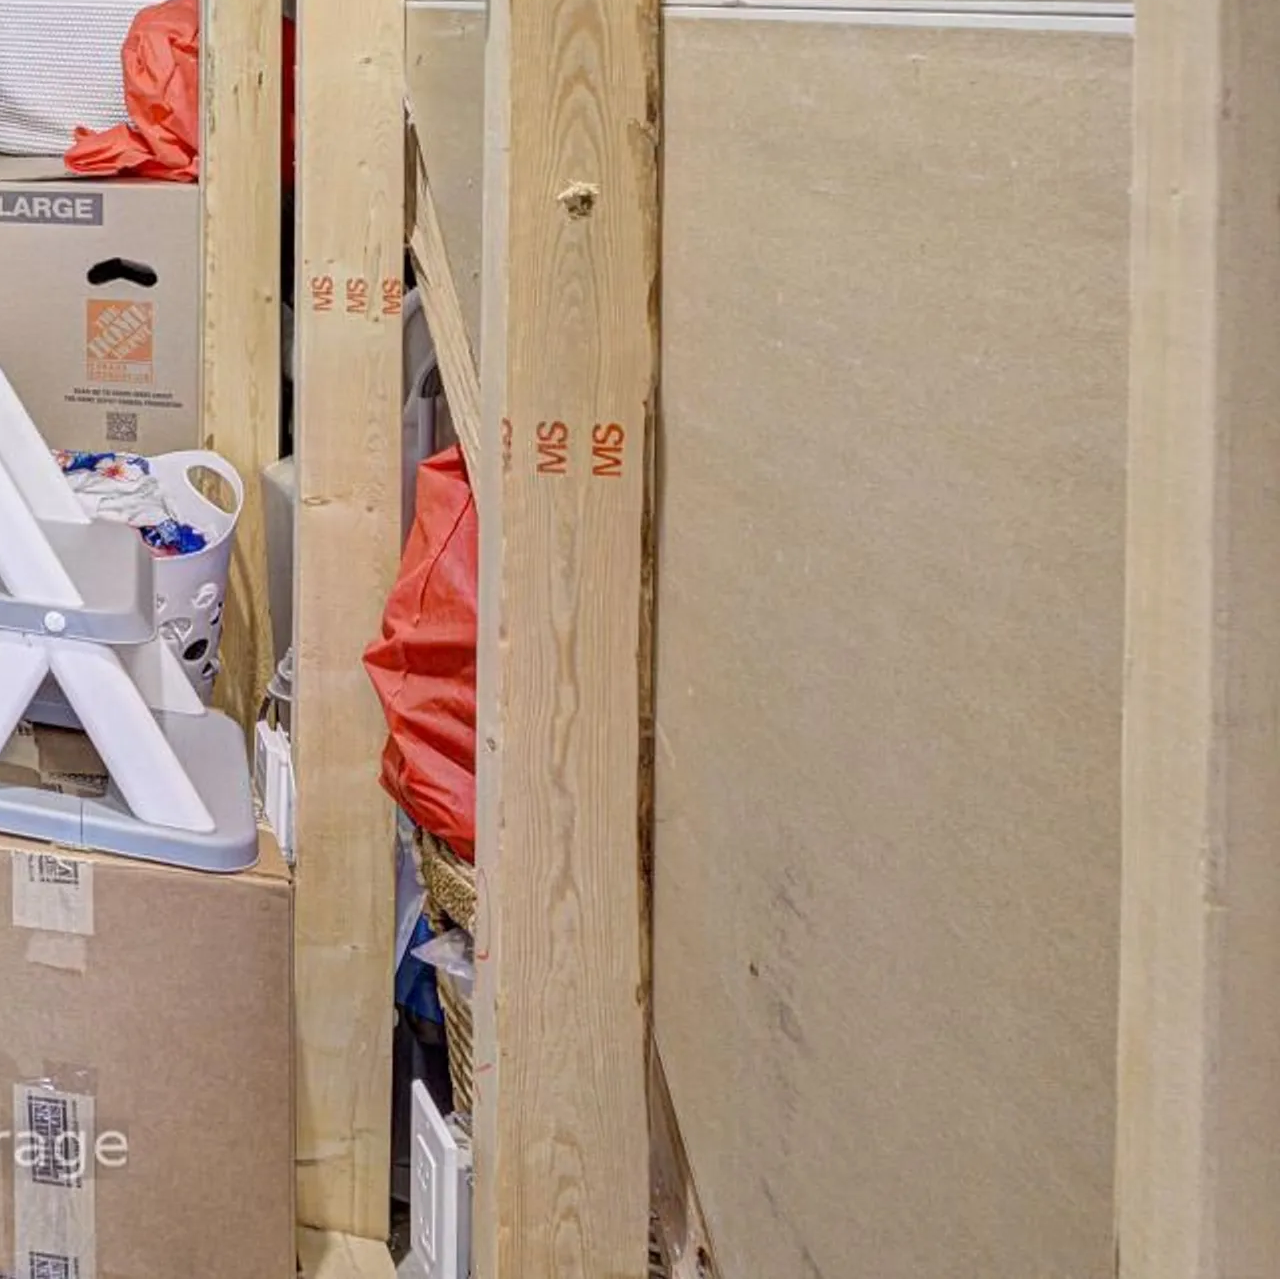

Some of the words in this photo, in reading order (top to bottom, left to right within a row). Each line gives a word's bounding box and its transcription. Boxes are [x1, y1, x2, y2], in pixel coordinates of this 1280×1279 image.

[312, 275, 334, 311] MS
[346, 278, 368, 313] MS
[382, 277, 402, 314] MS
[536, 421, 568, 474] MS
[592, 423, 625, 477] MS
